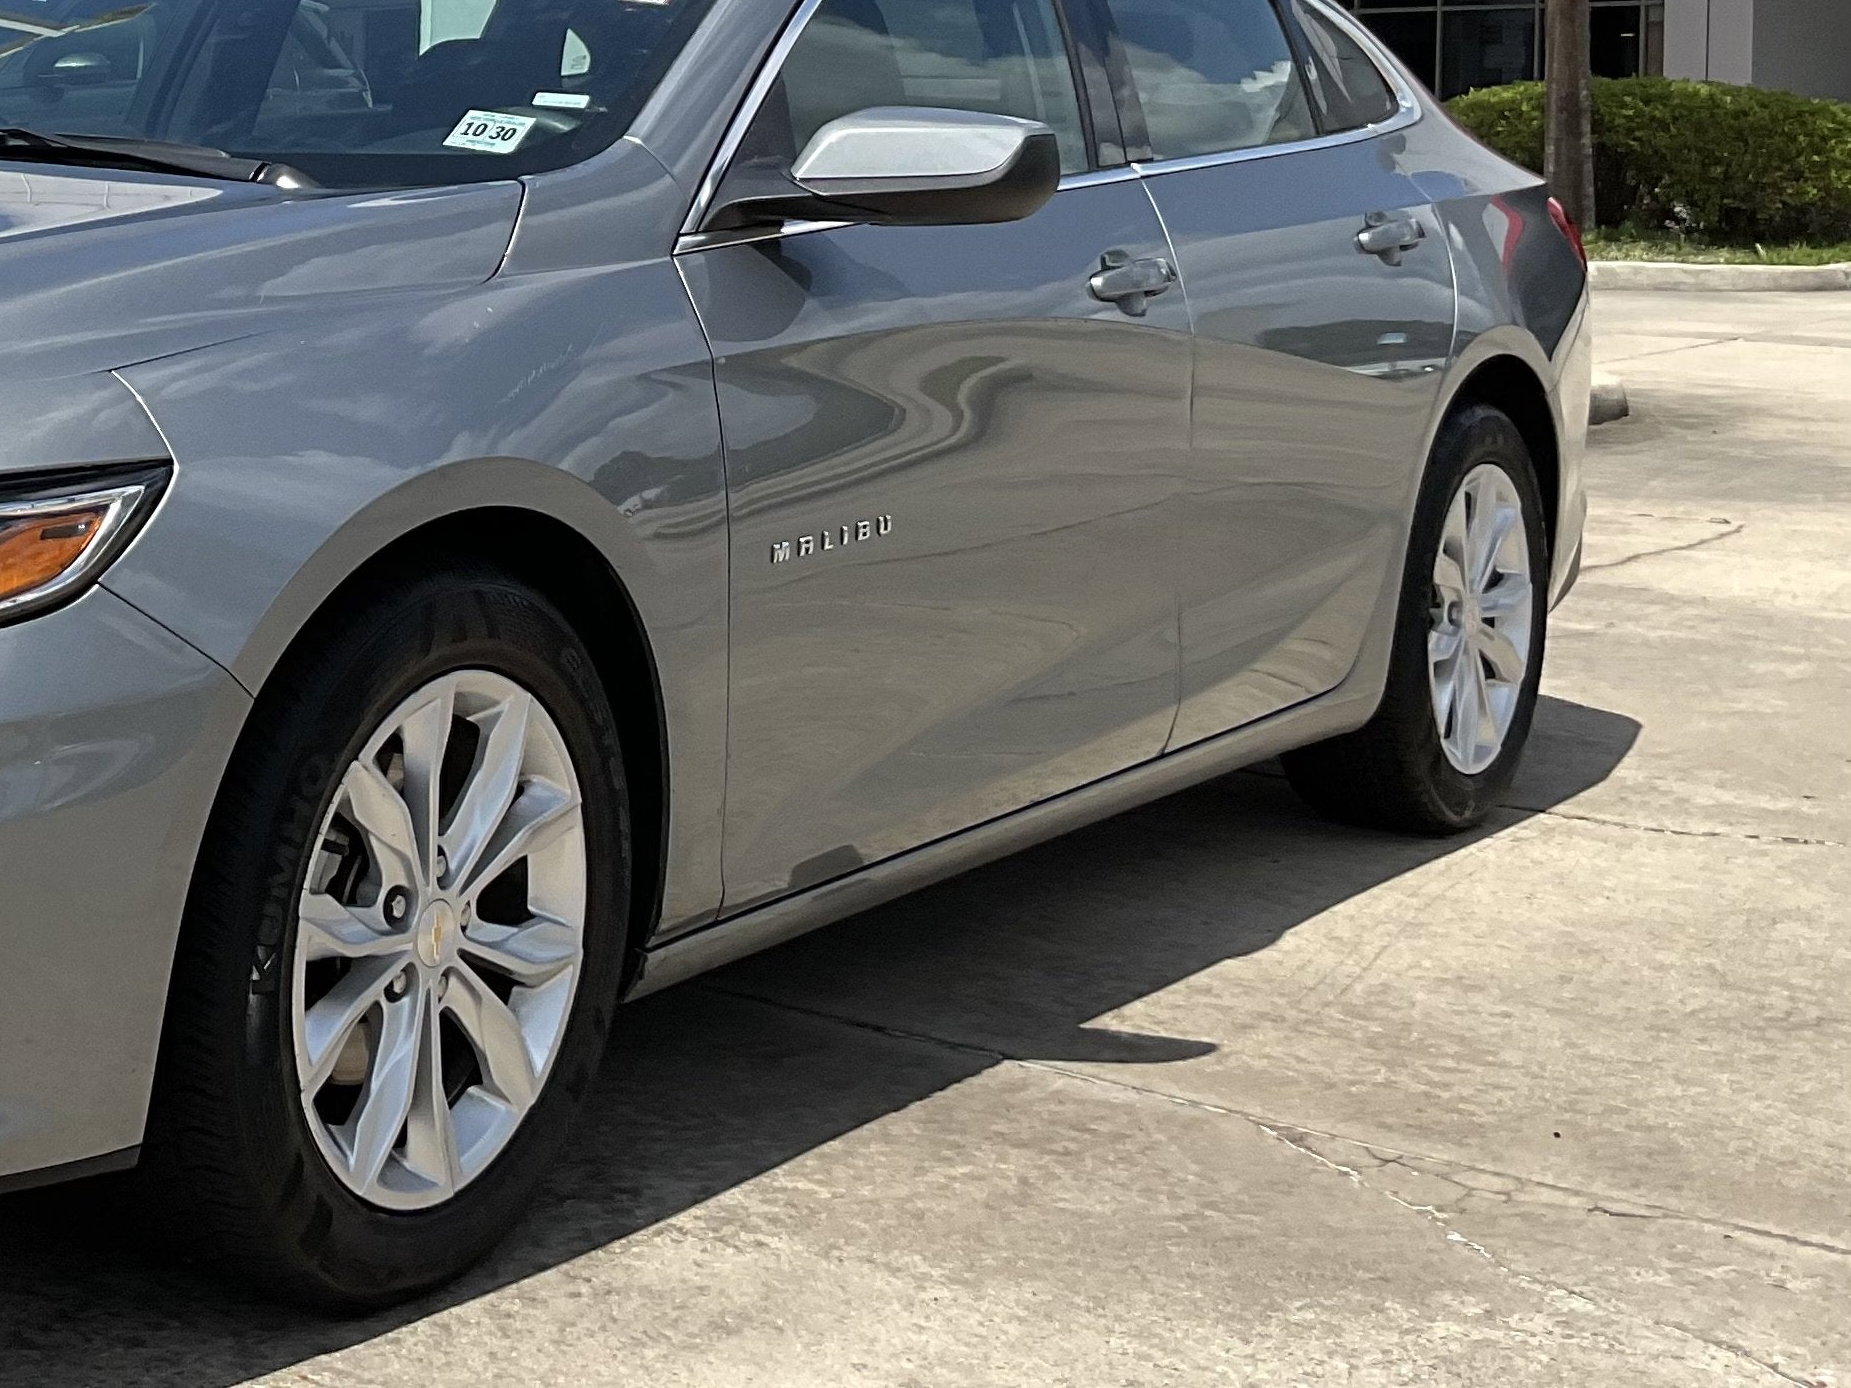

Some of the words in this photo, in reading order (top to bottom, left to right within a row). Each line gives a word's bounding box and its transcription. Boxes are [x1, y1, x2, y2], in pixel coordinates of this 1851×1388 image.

[460, 121, 489, 138] 10
[488, 125, 518, 142] 30
[770, 513, 892, 564] MALIBU
